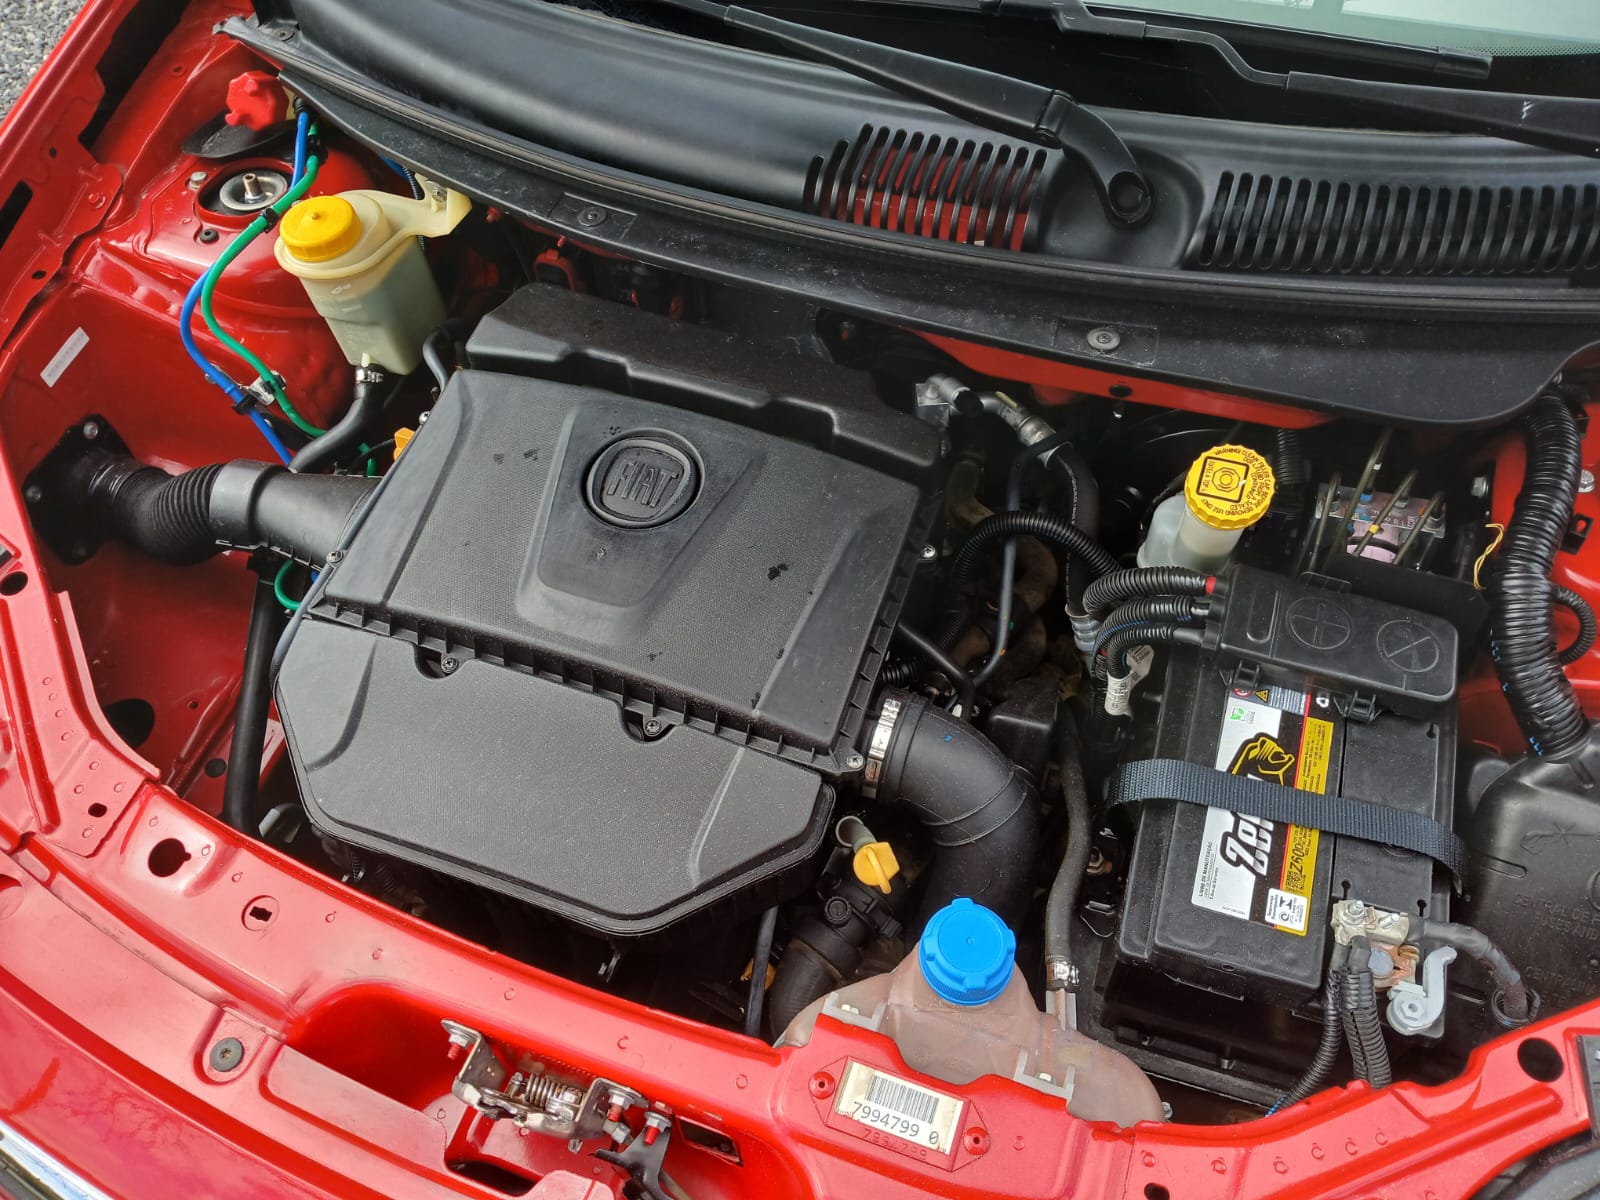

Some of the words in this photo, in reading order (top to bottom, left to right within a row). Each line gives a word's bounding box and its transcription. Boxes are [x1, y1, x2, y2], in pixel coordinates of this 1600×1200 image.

[1242, 450, 1259, 462] CLEAN
[607, 460, 680, 508] FIAT
[853, 1101, 920, 1137] 7994799
[928, 1130, 939, 1145] 0
